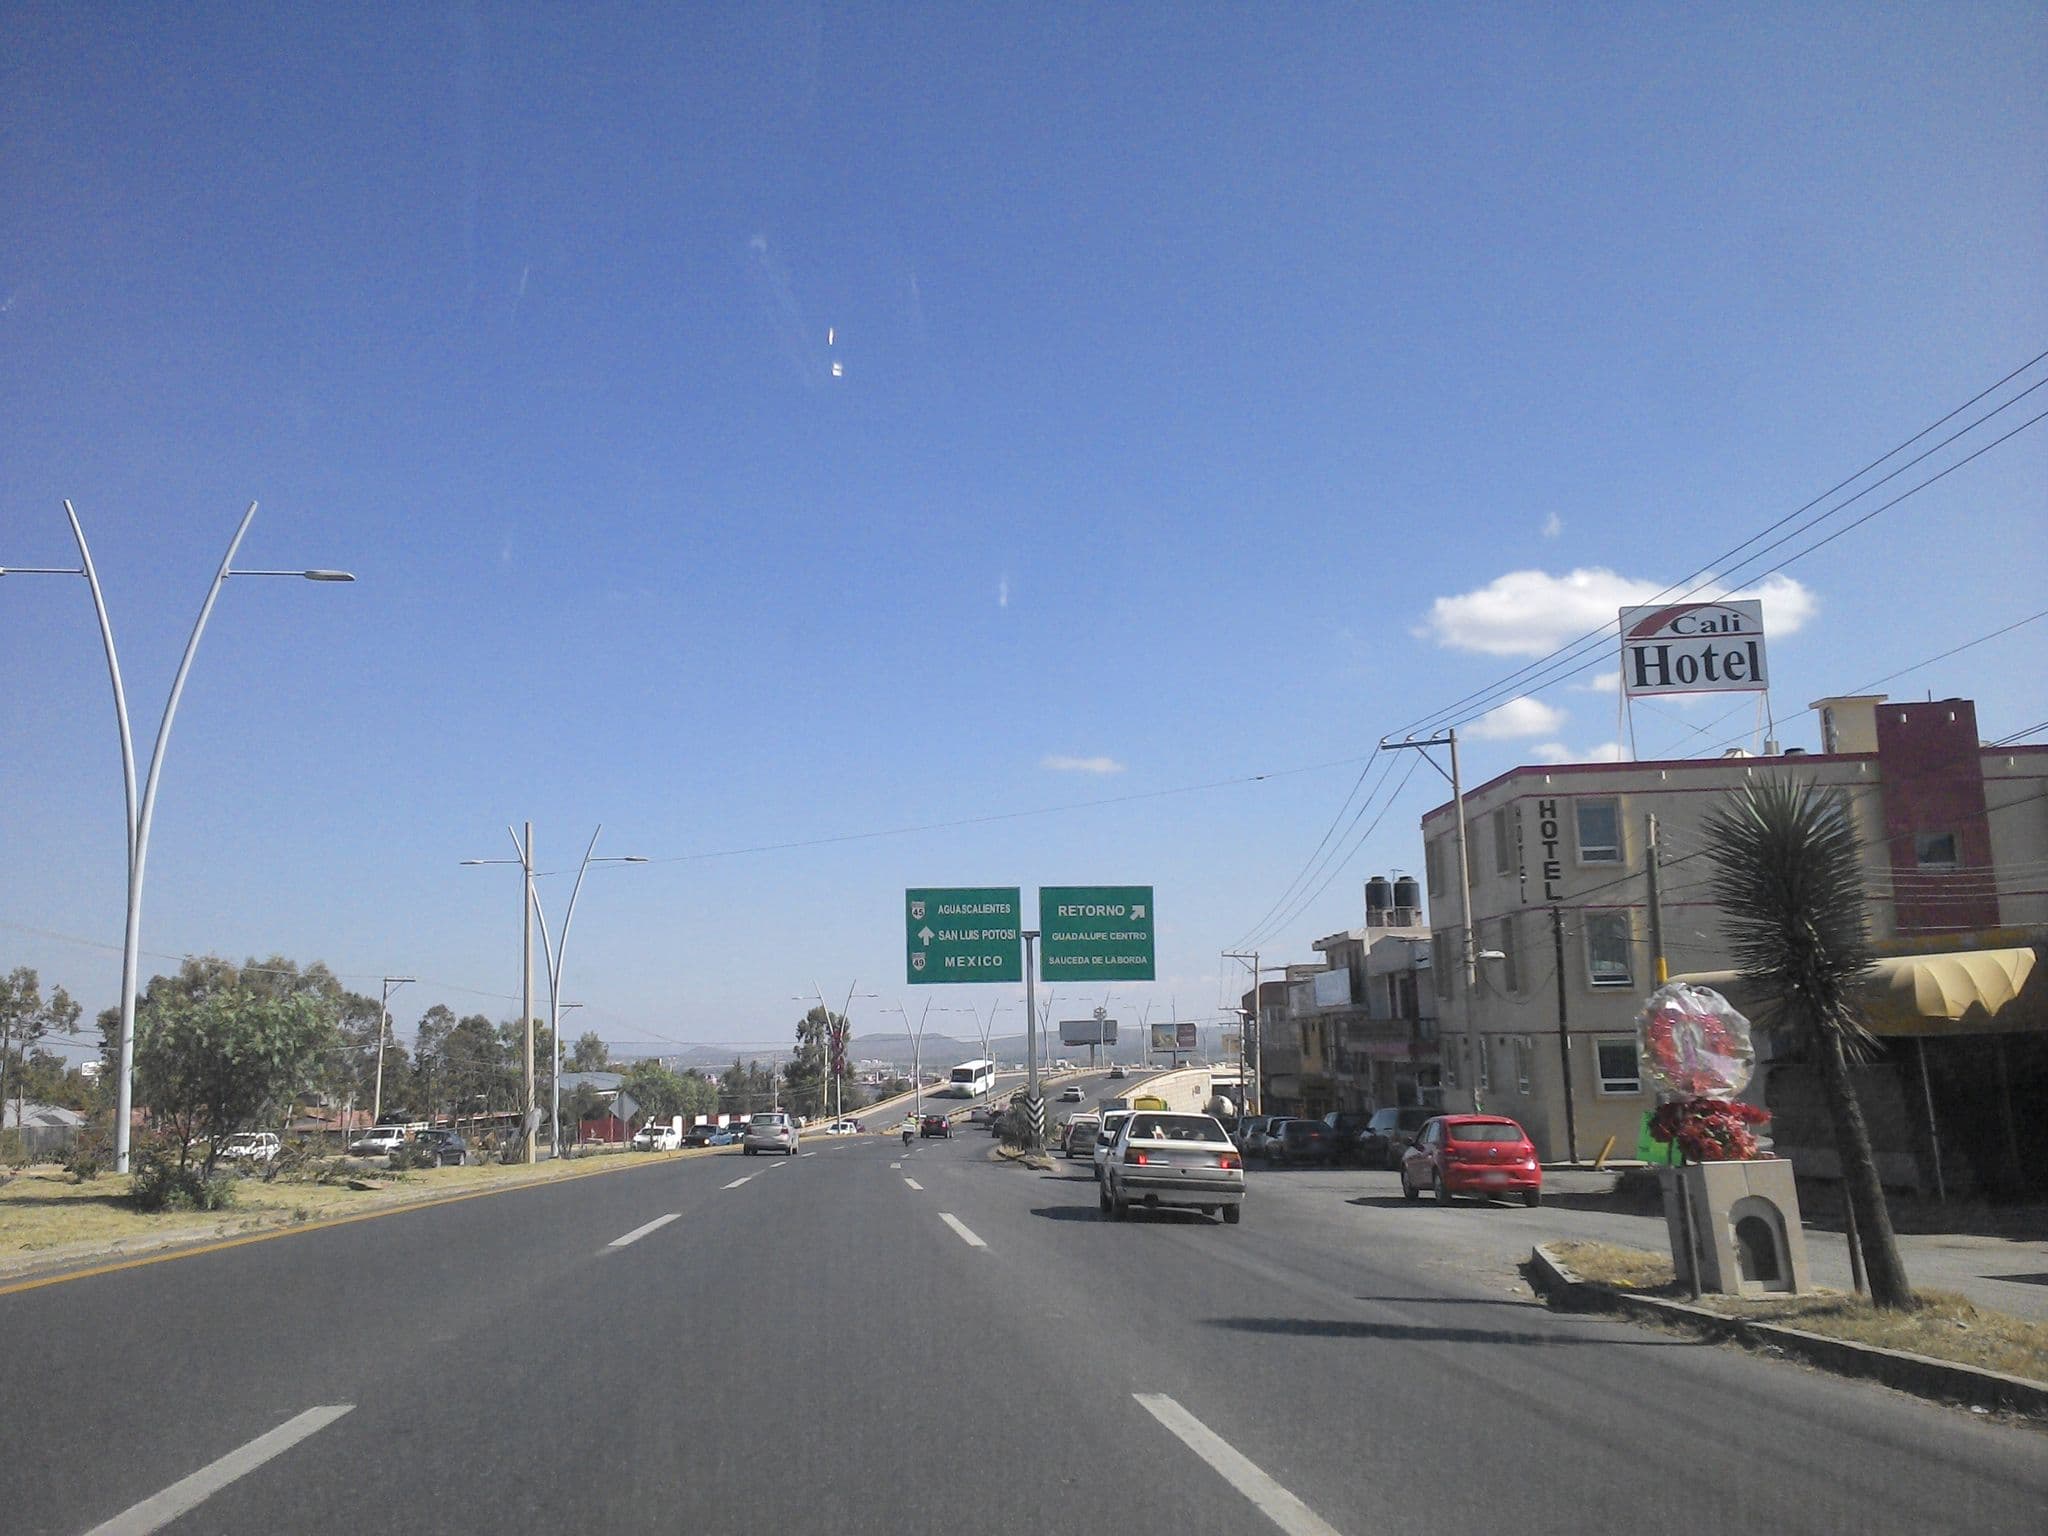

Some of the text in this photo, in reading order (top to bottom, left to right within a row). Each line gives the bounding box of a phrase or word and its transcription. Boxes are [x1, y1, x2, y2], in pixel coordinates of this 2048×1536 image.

[1669, 614, 1742, 635] Cali
[1629, 641, 1763, 687] Hotel
[1539, 800, 1563, 900] HOTEL
[913, 908, 924, 916] 45
[937, 903, 1011, 914] AGUASCALIENTES
[1058, 904, 1125, 916] RETORNO
[938, 929, 1016, 941] SAN LUIS POTOSI
[1052, 932, 1147, 941] GUADALUPE CENTRO
[944, 955, 1003, 967] MEXICO
[1049, 956, 1090, 965] SAUCEDA
[1091, 956, 1103, 964] DE
